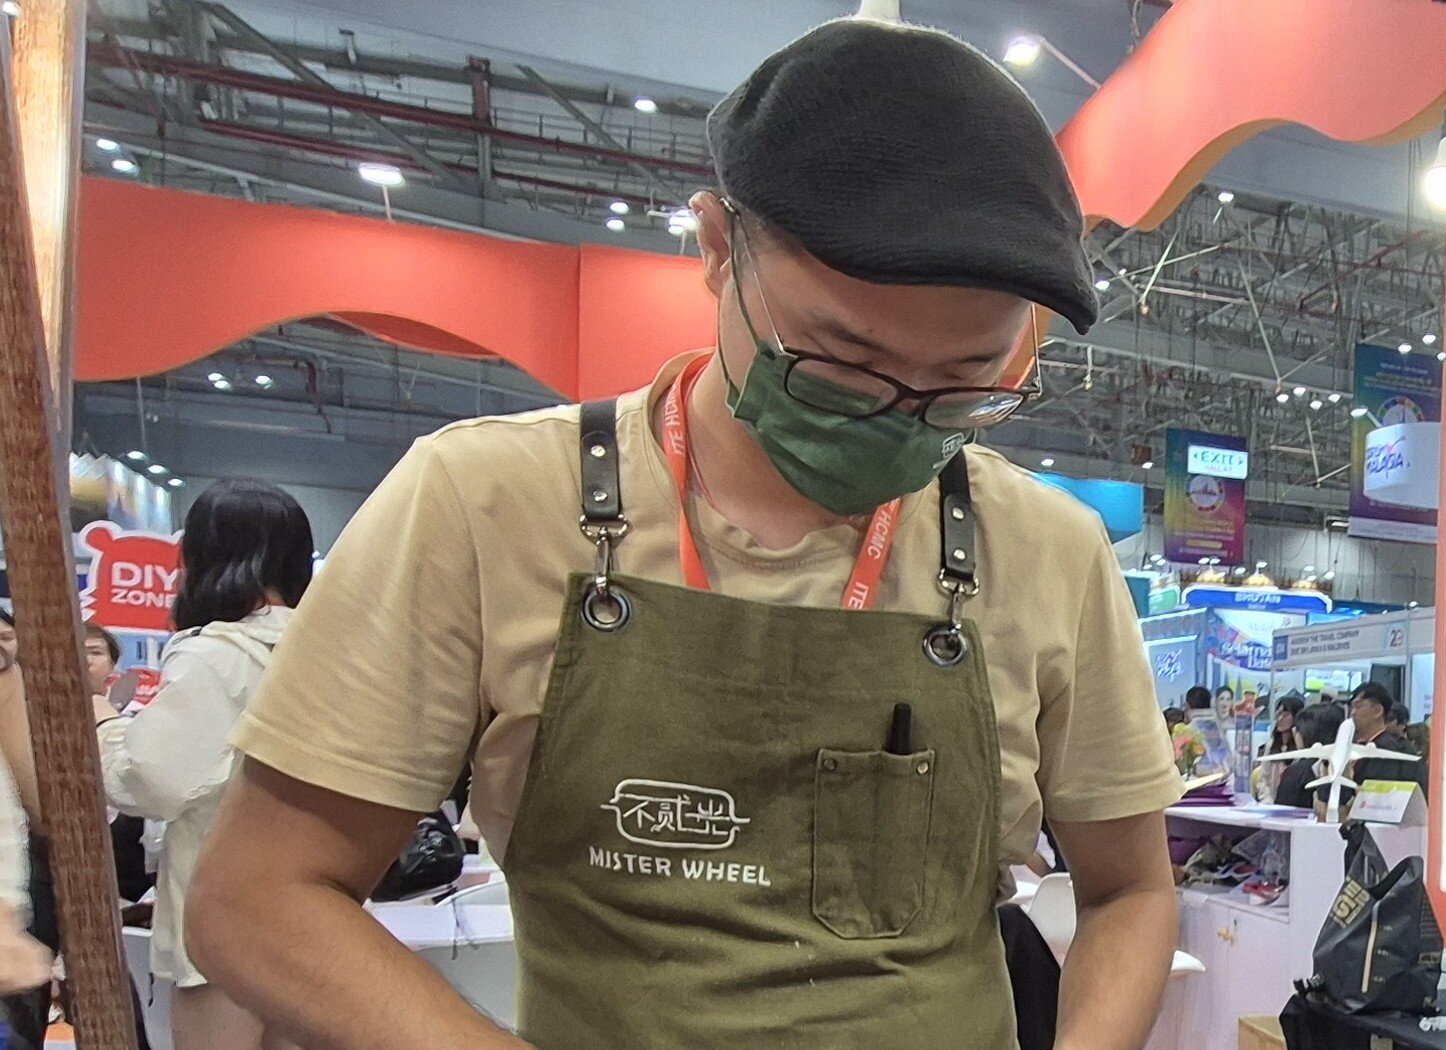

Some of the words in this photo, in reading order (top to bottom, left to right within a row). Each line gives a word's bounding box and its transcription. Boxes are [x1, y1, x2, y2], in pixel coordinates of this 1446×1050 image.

[668, 430, 686, 458] ITE
[1201, 450, 1234, 466] EXIT
[867, 509, 892, 561] HCMC
[111, 561, 180, 591] DIY
[111, 587, 178, 609] ZONE
[847, 580, 869, 609] ITE
[588, 846, 672, 878] MISTER
[681, 857, 772, 887] WHEEL
